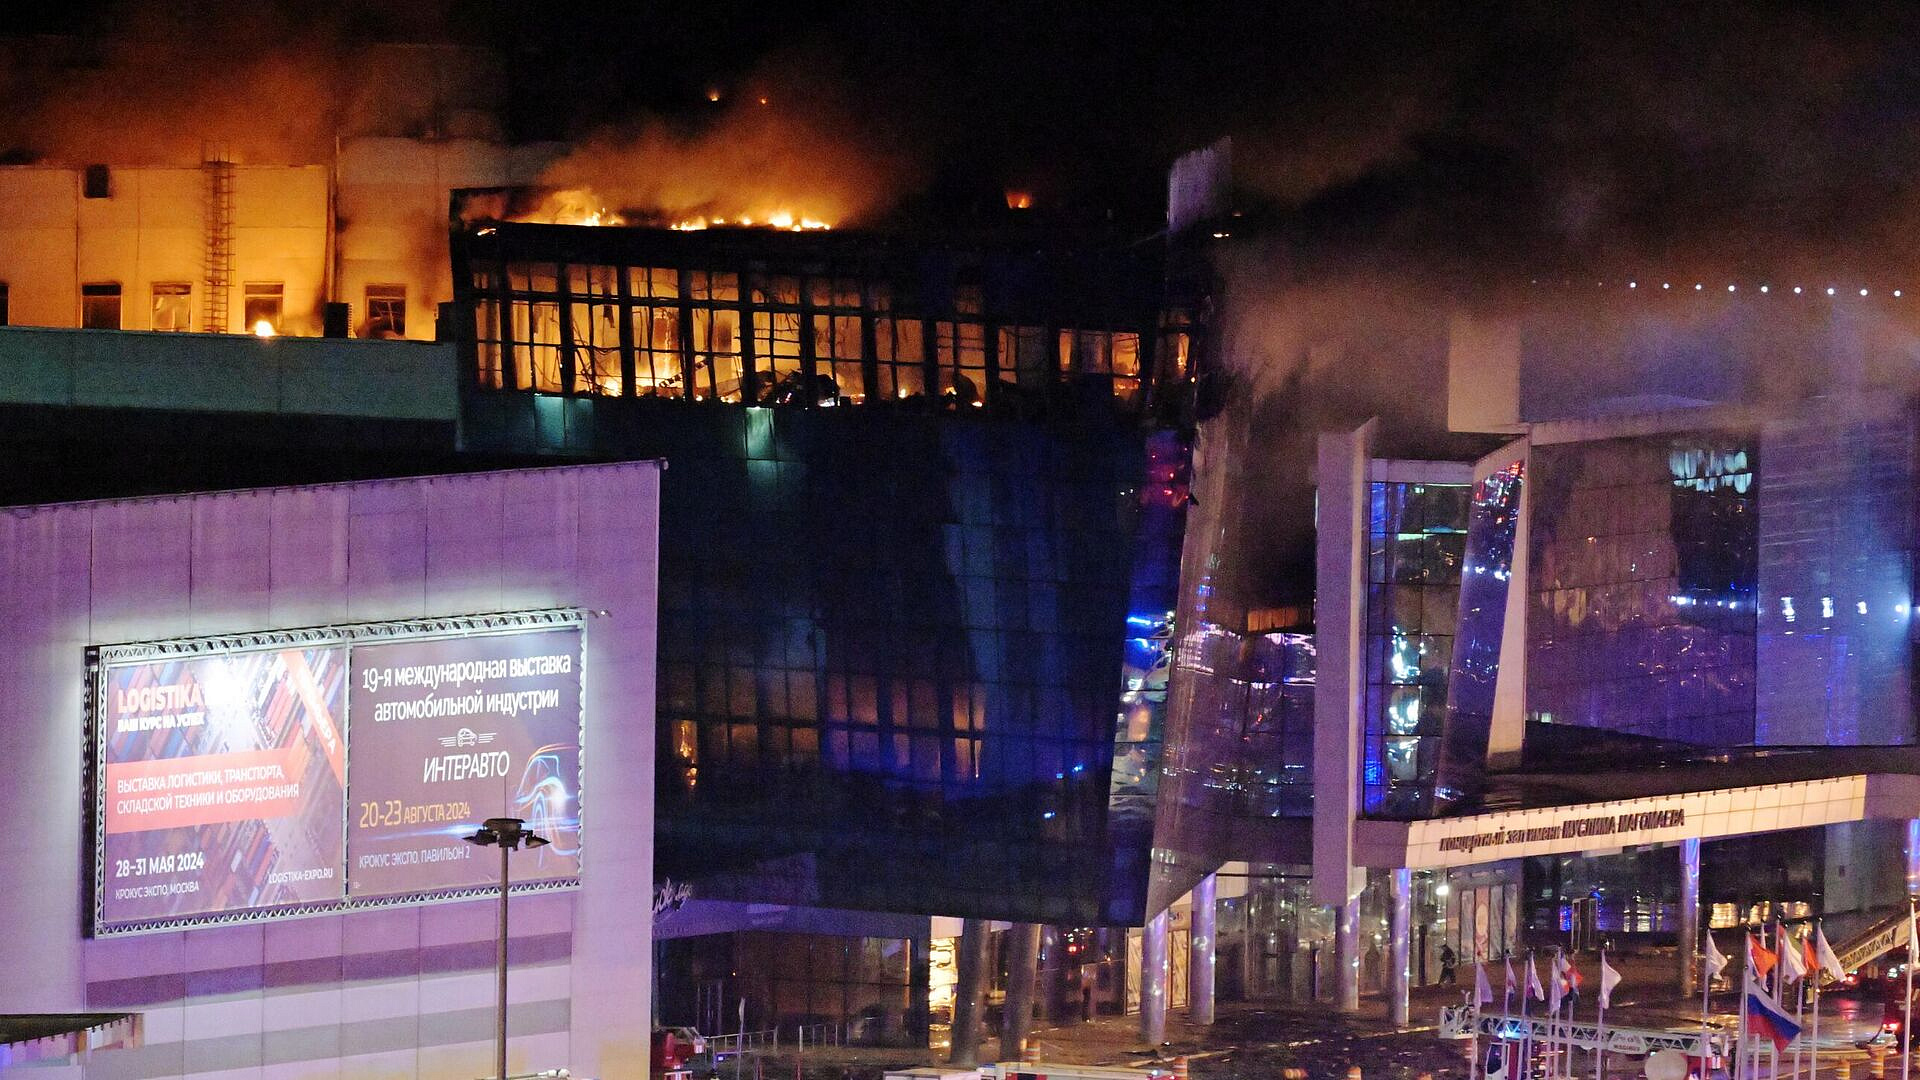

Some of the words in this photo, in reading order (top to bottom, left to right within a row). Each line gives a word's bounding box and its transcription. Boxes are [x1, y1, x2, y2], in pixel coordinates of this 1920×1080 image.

[362, 667, 392, 692] 19-я
[394, 659, 507, 689] международная
[510, 654, 571, 676] выставка
[117, 682, 203, 714] LOGISTIKA
[374, 690, 482, 721] автомобильной
[486, 689, 559, 717] индустрии
[139, 715, 163, 731] КУРС
[163, 714, 176, 729] НА
[117, 777, 165, 794] ВЫСТАВКА
[167, 770, 223, 789] ЛОГИСТИКИ,
[224, 765, 285, 784] ТРАНСПОРТА,
[423, 751, 510, 783] ИНТЕРАВТО
[117, 793, 172, 815] СКЛАДСКОЙ
[175, 791, 215, 809] ТЕХНИКИ
[216, 791, 222, 805] И
[225, 783, 300, 804] ОБОРУДОВАНИЯ
[360, 800, 402, 828] 20-23
[404, 804, 445, 824] АВГУСТА
[446, 802, 471, 821] 2024
[1562, 815, 1616, 839] МУСЛИМА
[1617, 808, 1685, 834] МАГОМАЕВА
[115, 857, 147, 878] 28-31
[149, 855, 174, 875] МАЯ
[177, 851, 205, 871] 2024
[359, 853, 390, 869] КРОКУС
[421, 847, 465, 863] ПАВИЛЬОН
[465, 845, 471, 859] 2
[115, 886, 143, 900] КРОКУС
[170, 881, 200, 895] МОСКВА
[268, 867, 334, 885] LOGISTIKA-EXPO.RU
